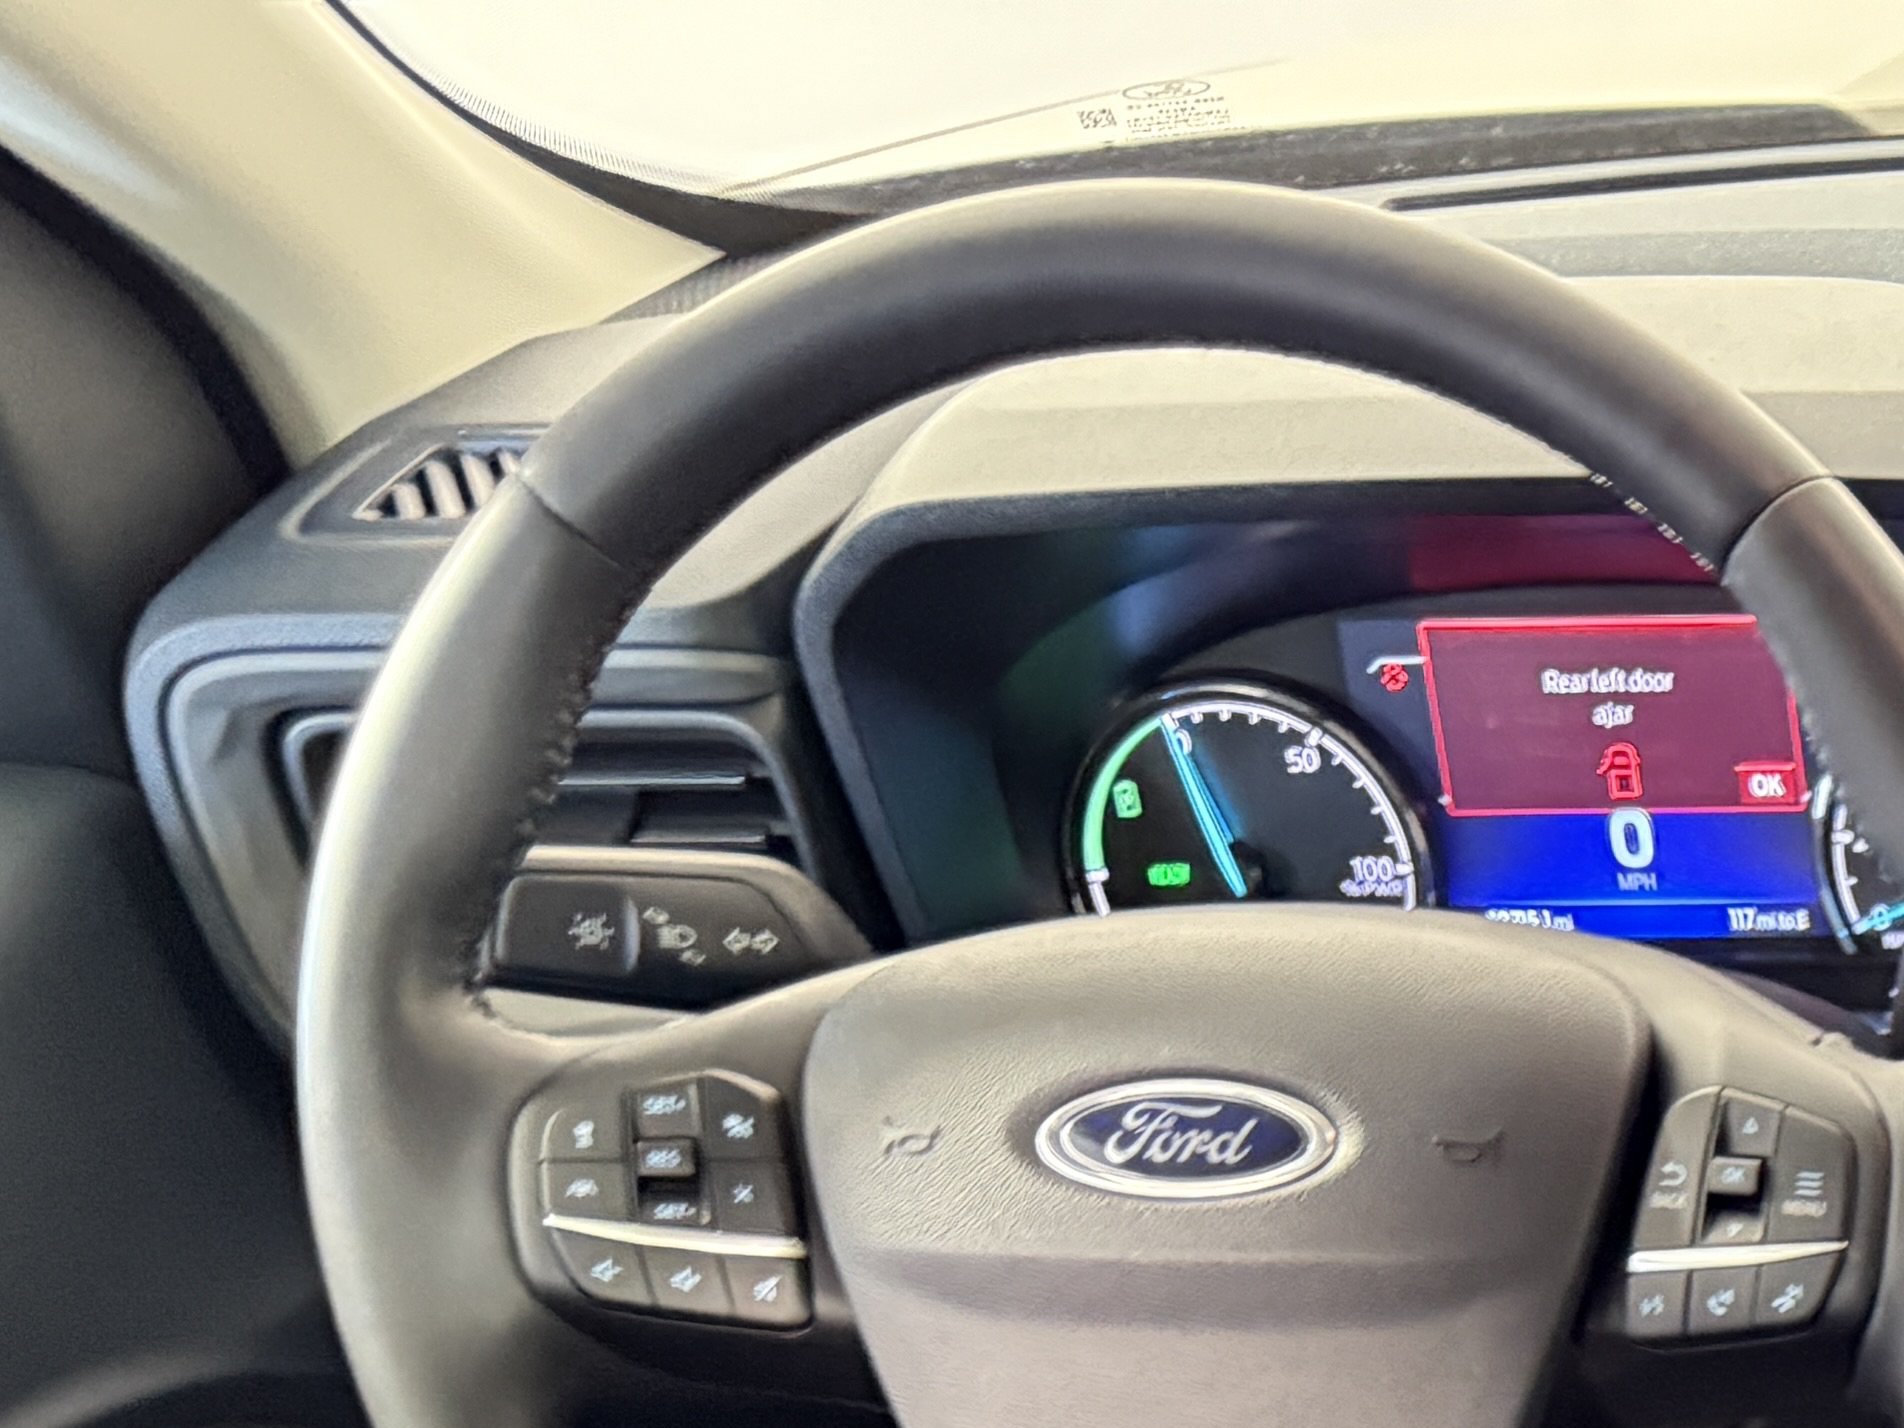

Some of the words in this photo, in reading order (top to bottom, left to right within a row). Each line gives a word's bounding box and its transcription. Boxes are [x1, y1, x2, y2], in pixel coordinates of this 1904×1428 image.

[1541, 668, 1590, 694] Rear
[1591, 667, 1626, 693] left
[1627, 667, 1675, 694] door
[1591, 701, 1635, 729] ajar
[1284, 746, 1321, 774] 50
[1748, 773, 1787, 799] OK
[1608, 806, 1655, 870] 0
[1350, 856, 1395, 881] 100
[1616, 872, 1658, 892] MPH
[1104, 1101, 1258, 1165] Ford
